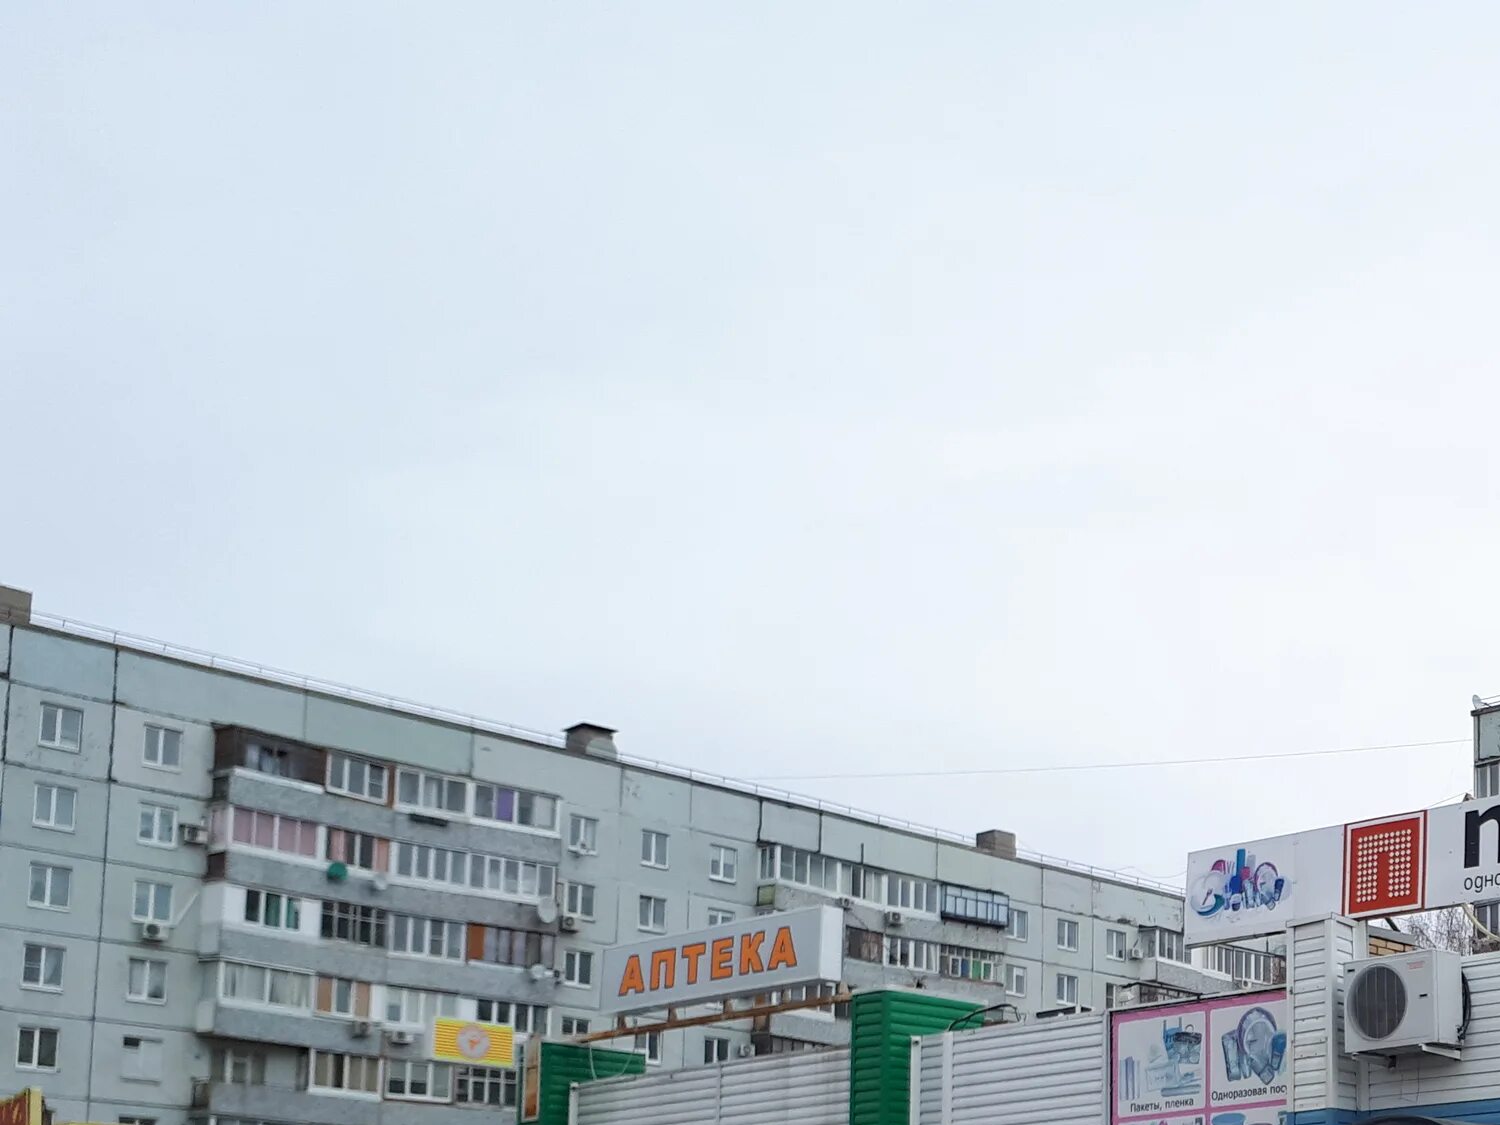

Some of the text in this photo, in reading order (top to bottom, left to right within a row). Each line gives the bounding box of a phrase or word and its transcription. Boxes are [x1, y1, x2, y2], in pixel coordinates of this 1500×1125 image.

[618, 926, 798, 997] АПТЕКА
[1211, 1086, 1268, 1101] Одноразовая
[1164, 1098, 1194, 1110] пленка
